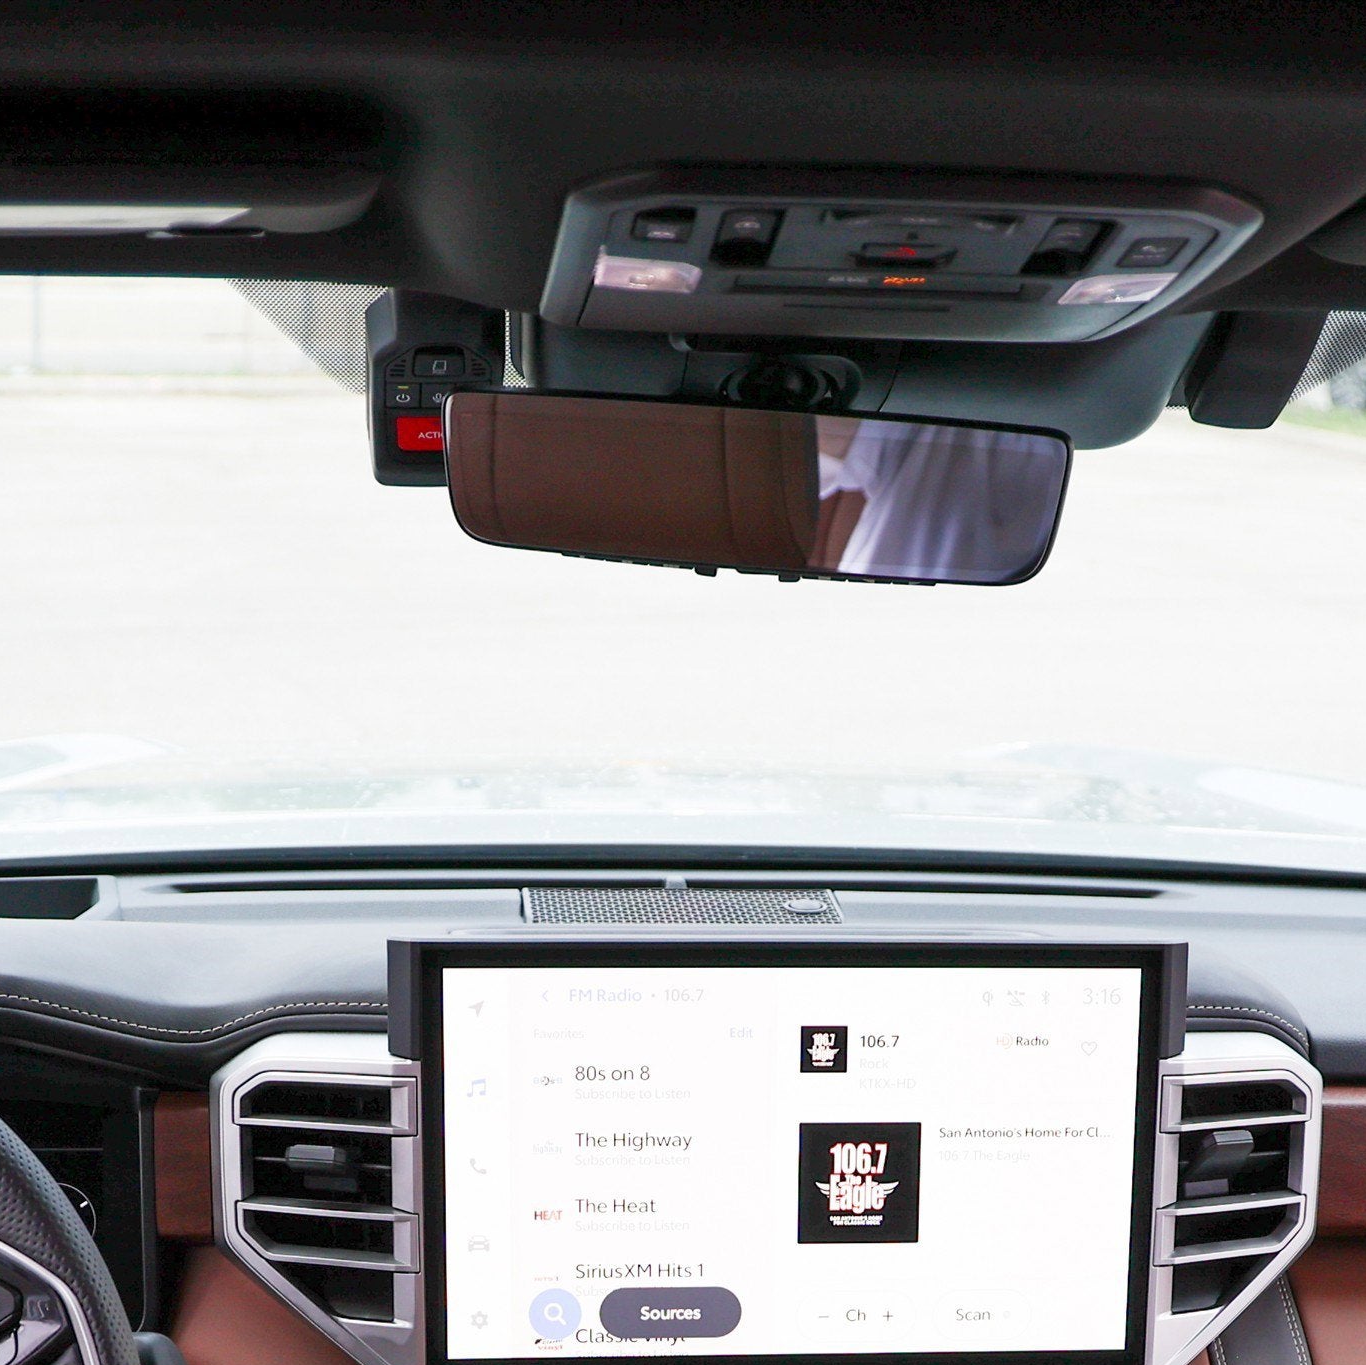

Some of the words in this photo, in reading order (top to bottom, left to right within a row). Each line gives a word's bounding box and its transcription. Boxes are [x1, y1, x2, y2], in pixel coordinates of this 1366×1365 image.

[418, 431, 443, 439] ACTI
[569, 989, 592, 1002] FM
[597, 988, 643, 1002] Radio
[664, 988, 704, 1002] 106.7
[1083, 988, 1122, 1005] 3:16
[729, 1027, 754, 1038] Edit
[860, 1034, 900, 1048] 106.7
[1015, 1036, 1049, 1047] Radio
[574, 1065, 606, 1081] 80s
[611, 1069, 635, 1081] on
[640, 1065, 650, 1081] 8
[939, 1127, 962, 1138] San
[964, 1126, 1022, 1138] Antonio's
[1025, 1127, 1061, 1138] Home
[1065, 1127, 1084, 1138] For
[574, 1132, 607, 1148] The
[613, 1131, 692, 1152] Highway
[829, 1142, 888, 1174] 106.7
[829, 1174, 886, 1214] Eagle
[574, 1198, 607, 1213] The
[613, 1198, 657, 1213] Heat
[533, 1210, 563, 1221] HEAT
[574, 1220, 636, 1232] Subscribe
[639, 1221, 652, 1232] to
[654, 1220, 690, 1232] Listen
[575, 1263, 652, 1279] SiriusXM
[657, 1263, 692, 1278] Hits
[697, 1264, 704, 1278] 1
[640, 1307, 701, 1320] Sources
[846, 1308, 866, 1321] Ch
[955, 1308, 992, 1321] Scan
